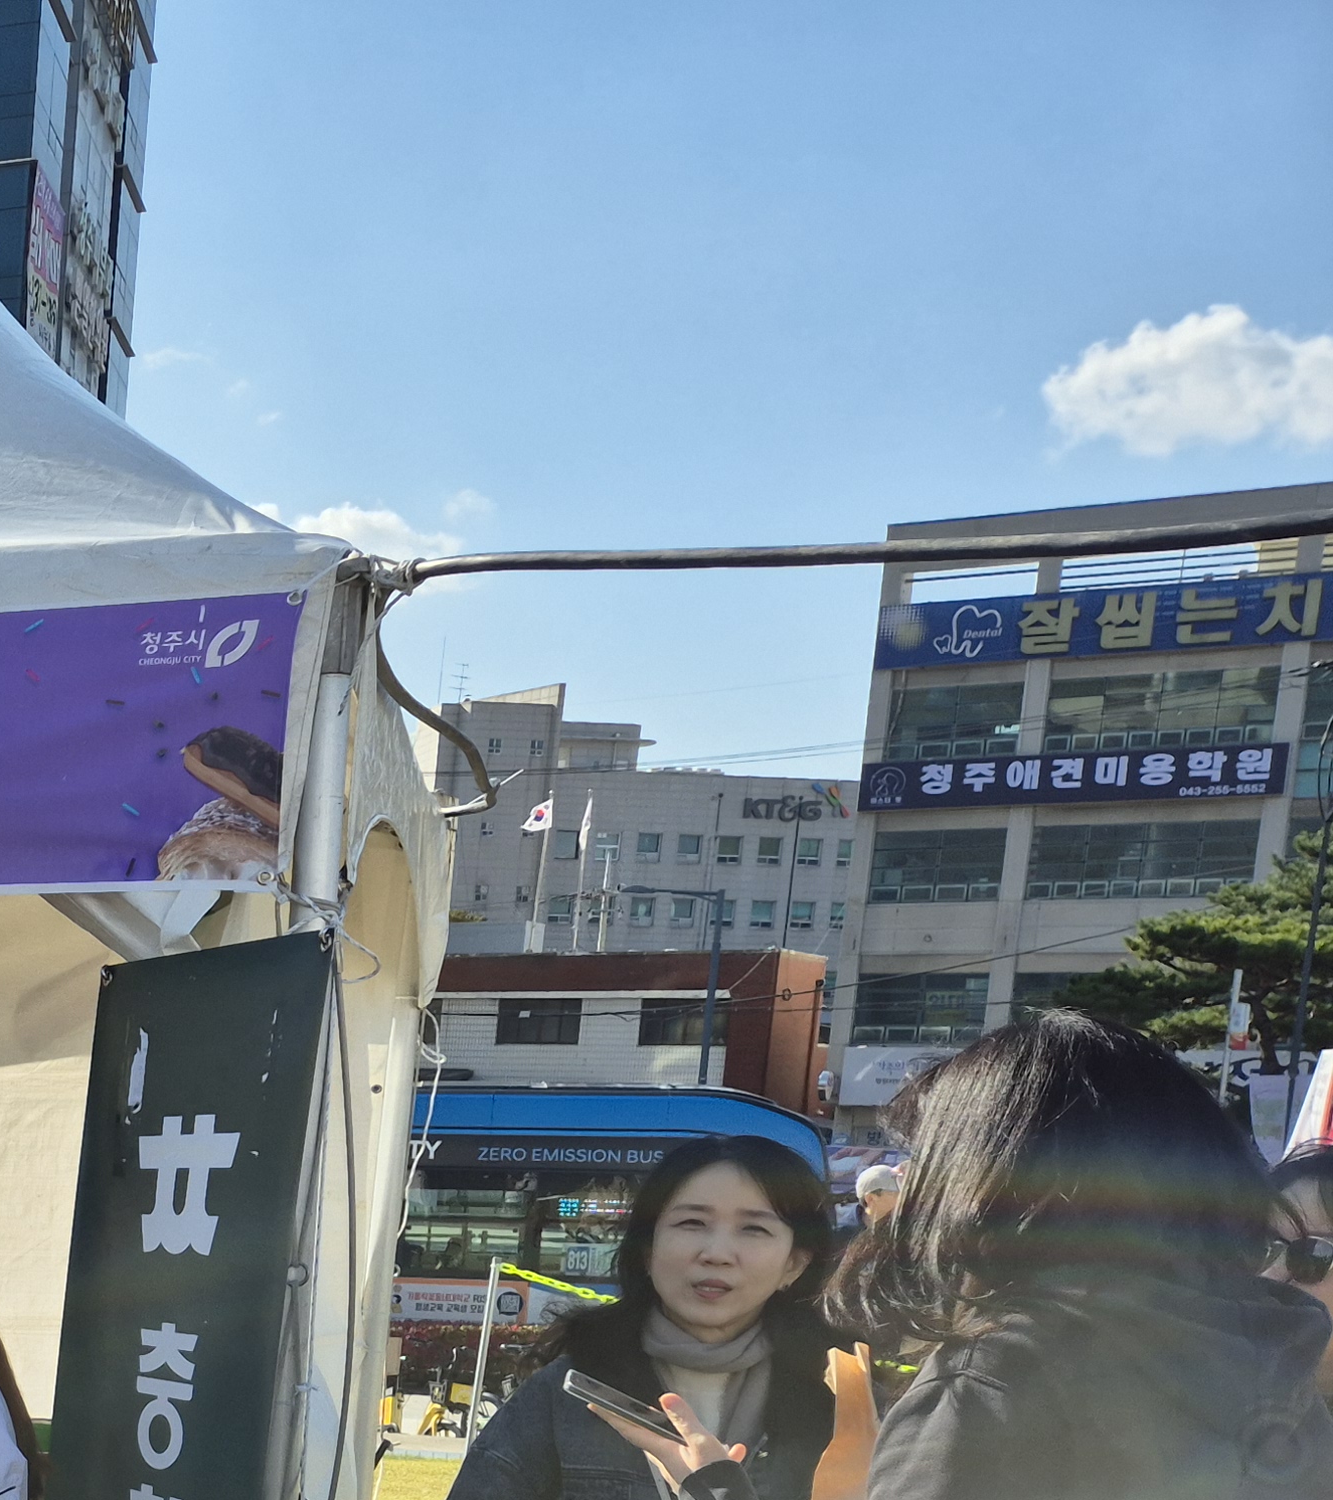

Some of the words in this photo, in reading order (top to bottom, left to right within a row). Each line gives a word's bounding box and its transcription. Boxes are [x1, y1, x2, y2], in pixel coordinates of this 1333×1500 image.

[140, 629, 207, 654] 청주시
[963, 627, 1003, 639] Dental
[138, 656, 182, 666] CHEONGJU
[183, 655, 202, 664] CITY
[742, 796, 823, 823] KT&G
[477, 1147, 527, 1162] ZERO
[532, 1148, 622, 1163] EMISSION
[626, 1149, 665, 1164] BUS
[567, 1250, 588, 1270] 813
